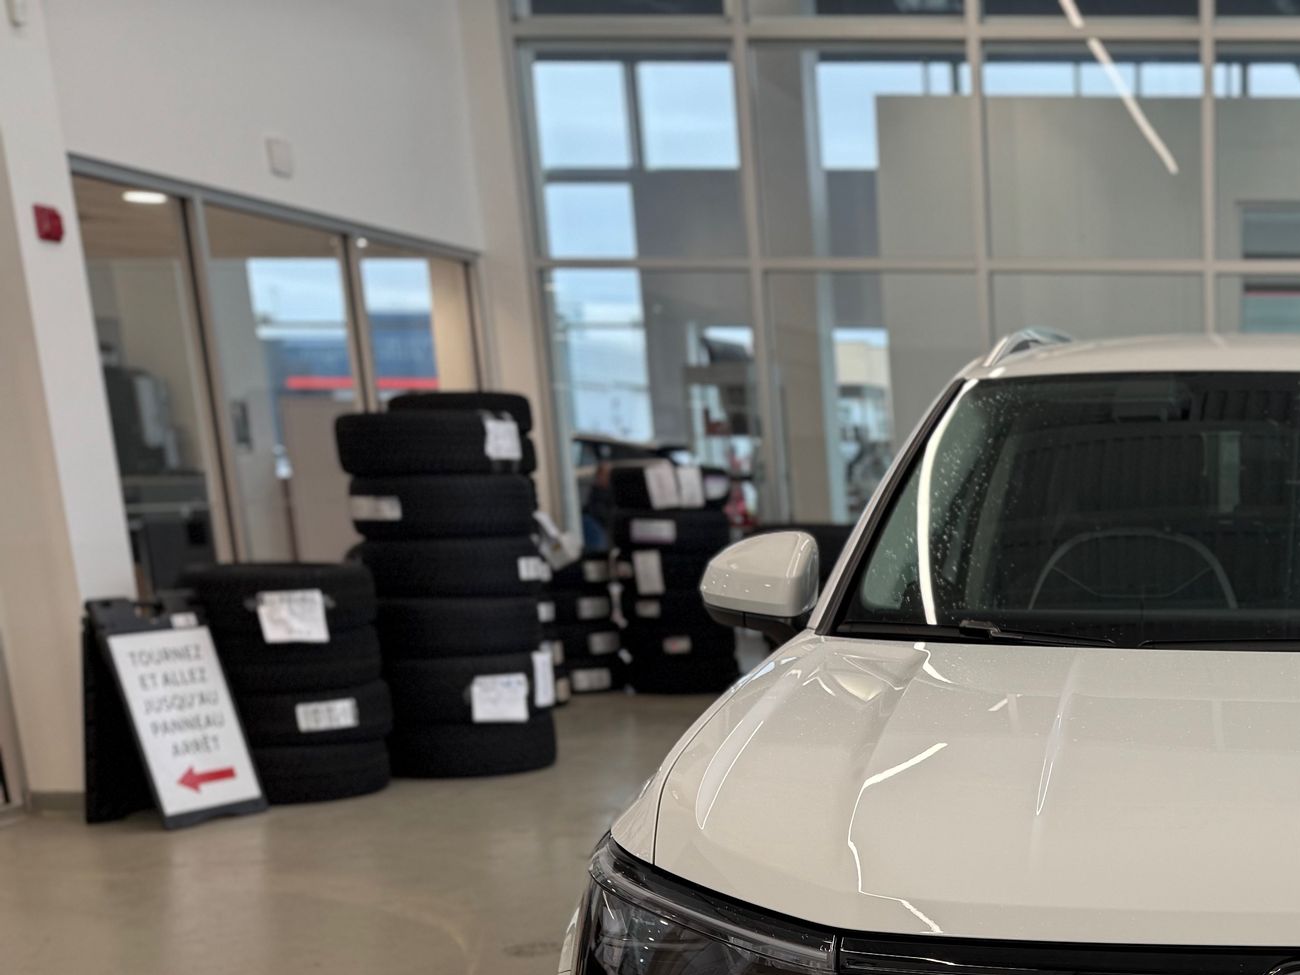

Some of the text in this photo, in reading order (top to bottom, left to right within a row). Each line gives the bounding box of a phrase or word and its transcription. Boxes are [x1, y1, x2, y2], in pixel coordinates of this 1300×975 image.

[128, 644, 202, 667] TOURNEZ
[138, 666, 206, 691] ET ALLEZ
[150, 712, 226, 738] PANNEAU
